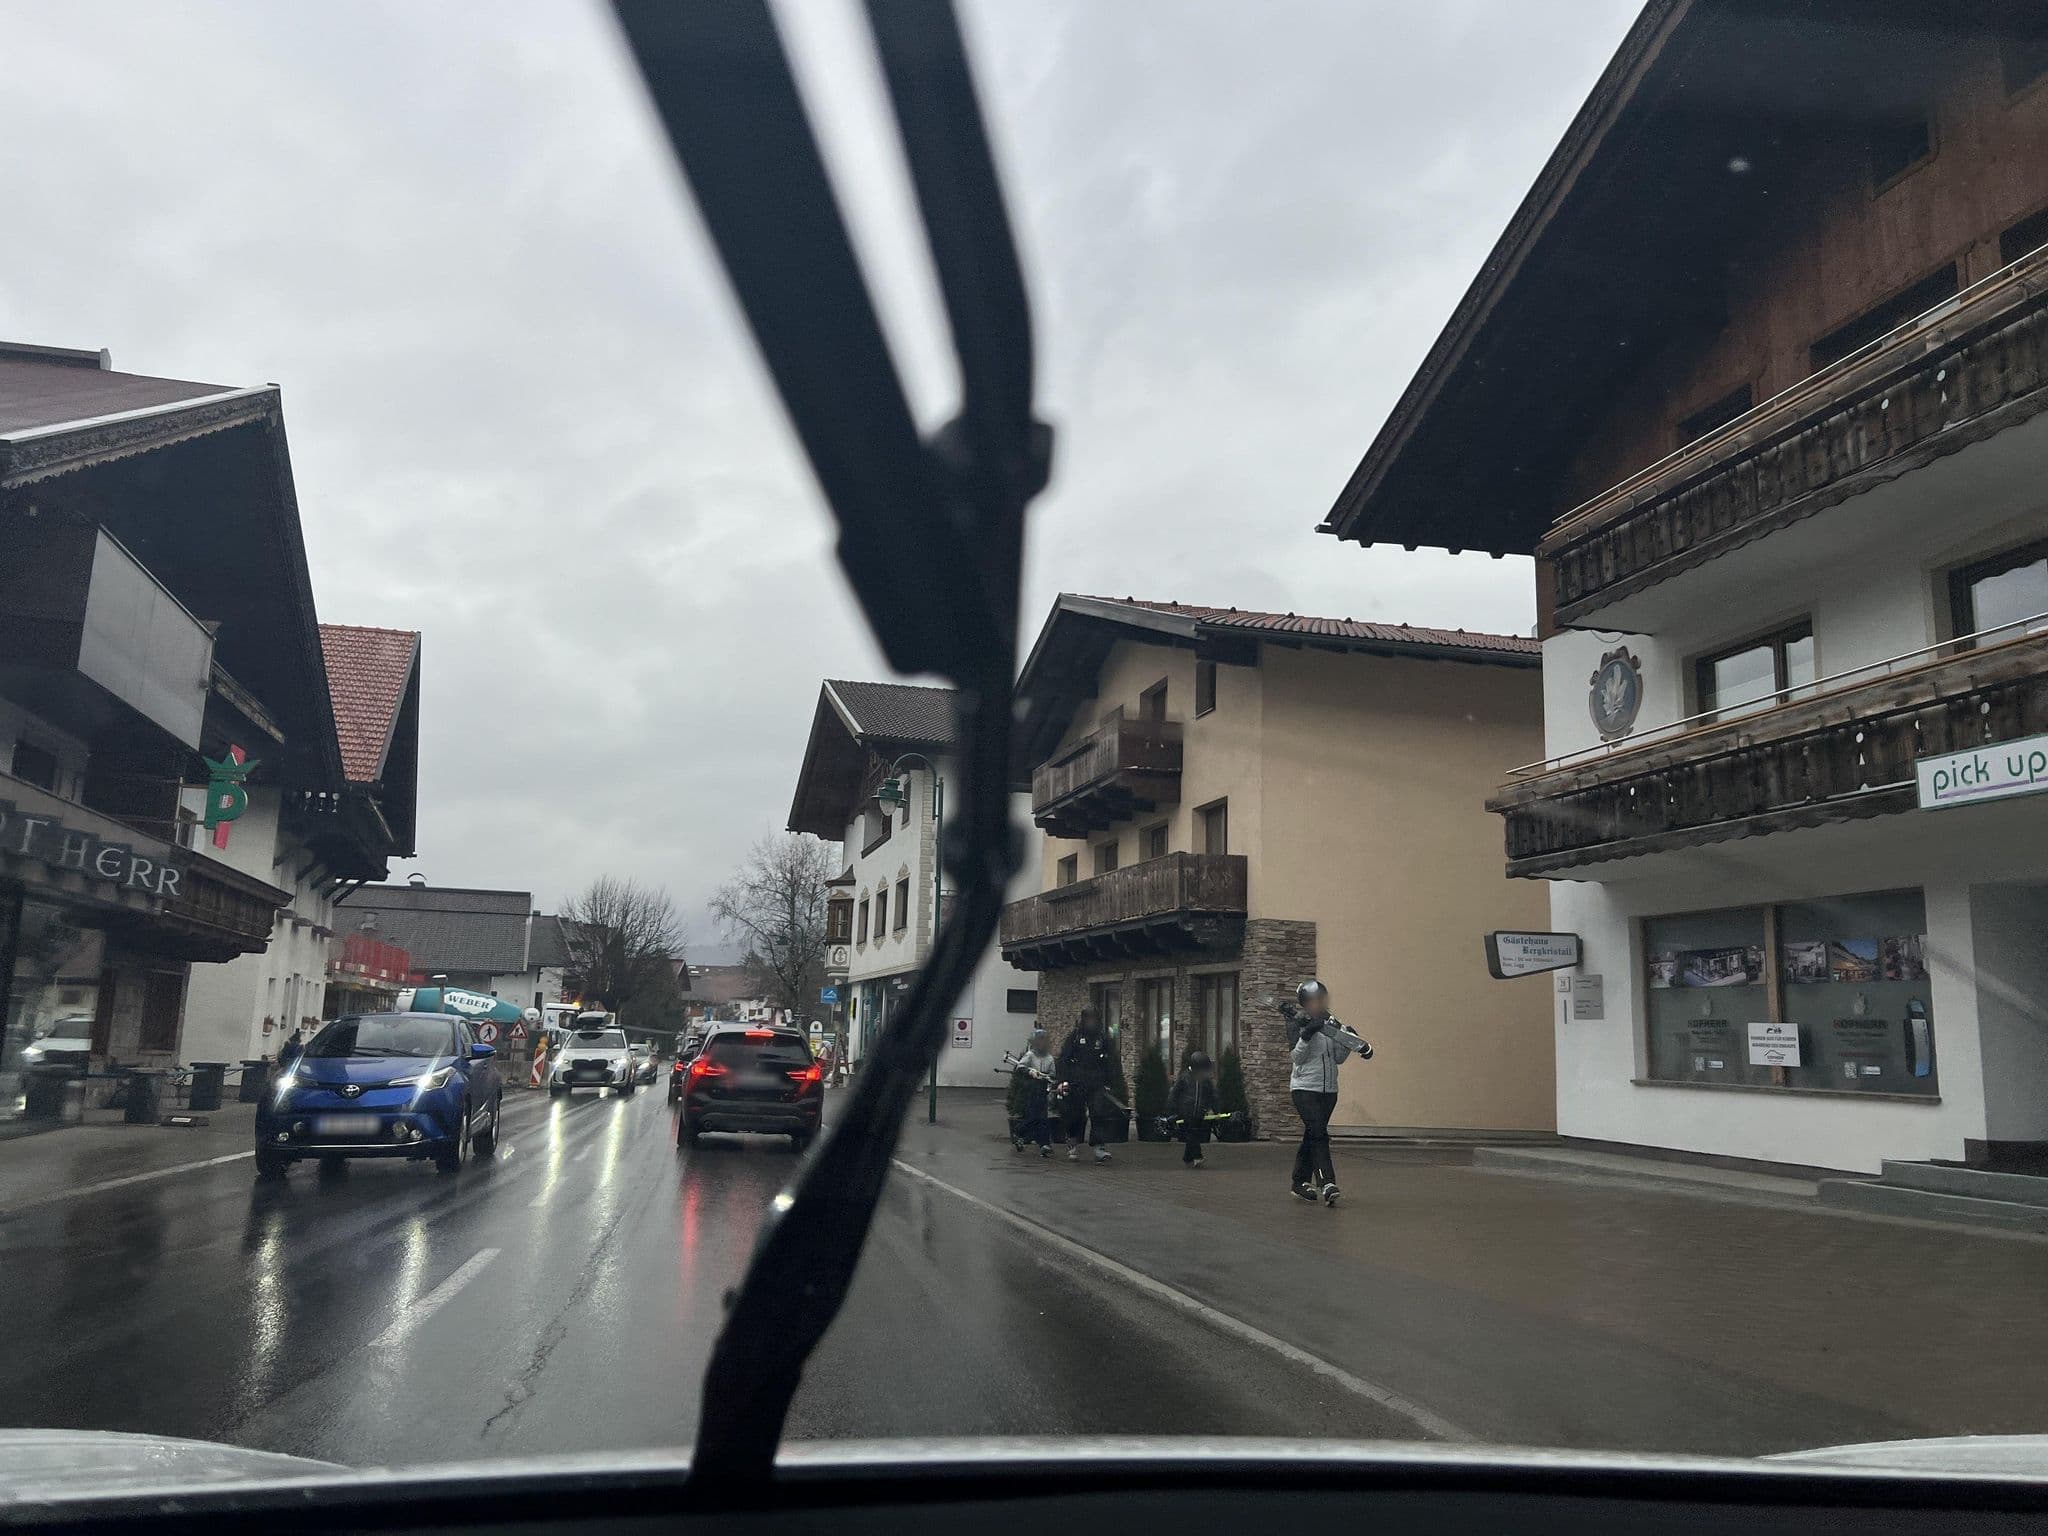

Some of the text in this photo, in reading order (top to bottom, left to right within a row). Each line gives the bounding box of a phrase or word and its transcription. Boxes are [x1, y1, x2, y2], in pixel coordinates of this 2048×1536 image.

[1933, 751, 2047, 800] pick up
[1503, 936, 1549, 945] Gästehaus
[448, 995, 490, 1009] WEBER
